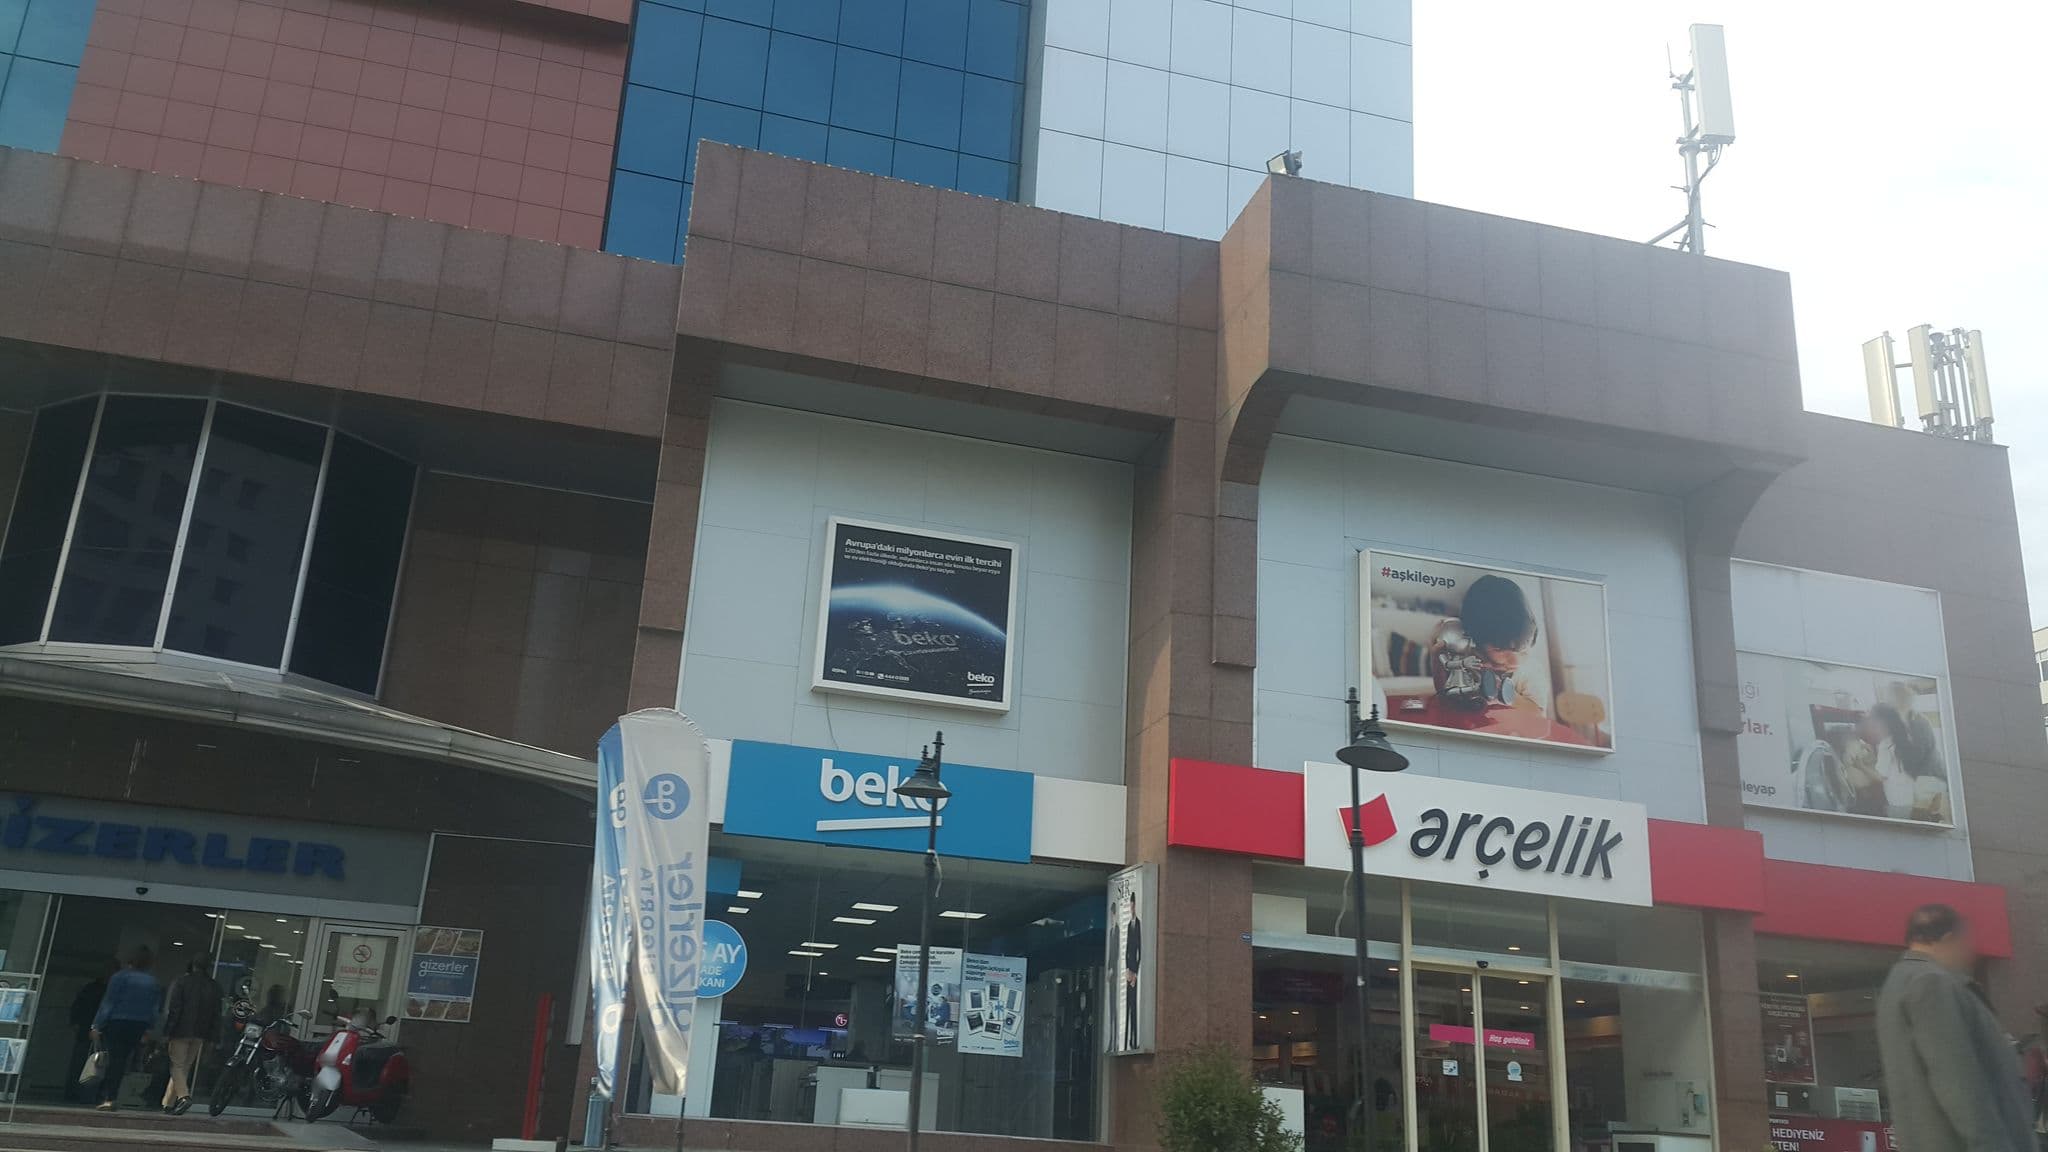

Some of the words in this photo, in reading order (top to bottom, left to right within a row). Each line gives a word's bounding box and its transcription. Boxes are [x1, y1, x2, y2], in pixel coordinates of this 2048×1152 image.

[845, 538, 894, 554] Avrupa'daki
[896, 545, 944, 561] milyonlarca
[946, 553, 963, 563] evin
[965, 555, 974, 564] ilk
[976, 557, 1002, 568] tercihi
[1381, 567, 1456, 588] #aşkileyap
[891, 629, 958, 647] beko
[967, 671, 995, 684] beko
[1743, 718, 1773, 736] lar.
[1741, 780, 1777, 796] leyap
[1409, 808, 1624, 880] arçelik
[418, 959, 470, 977] gizerler
